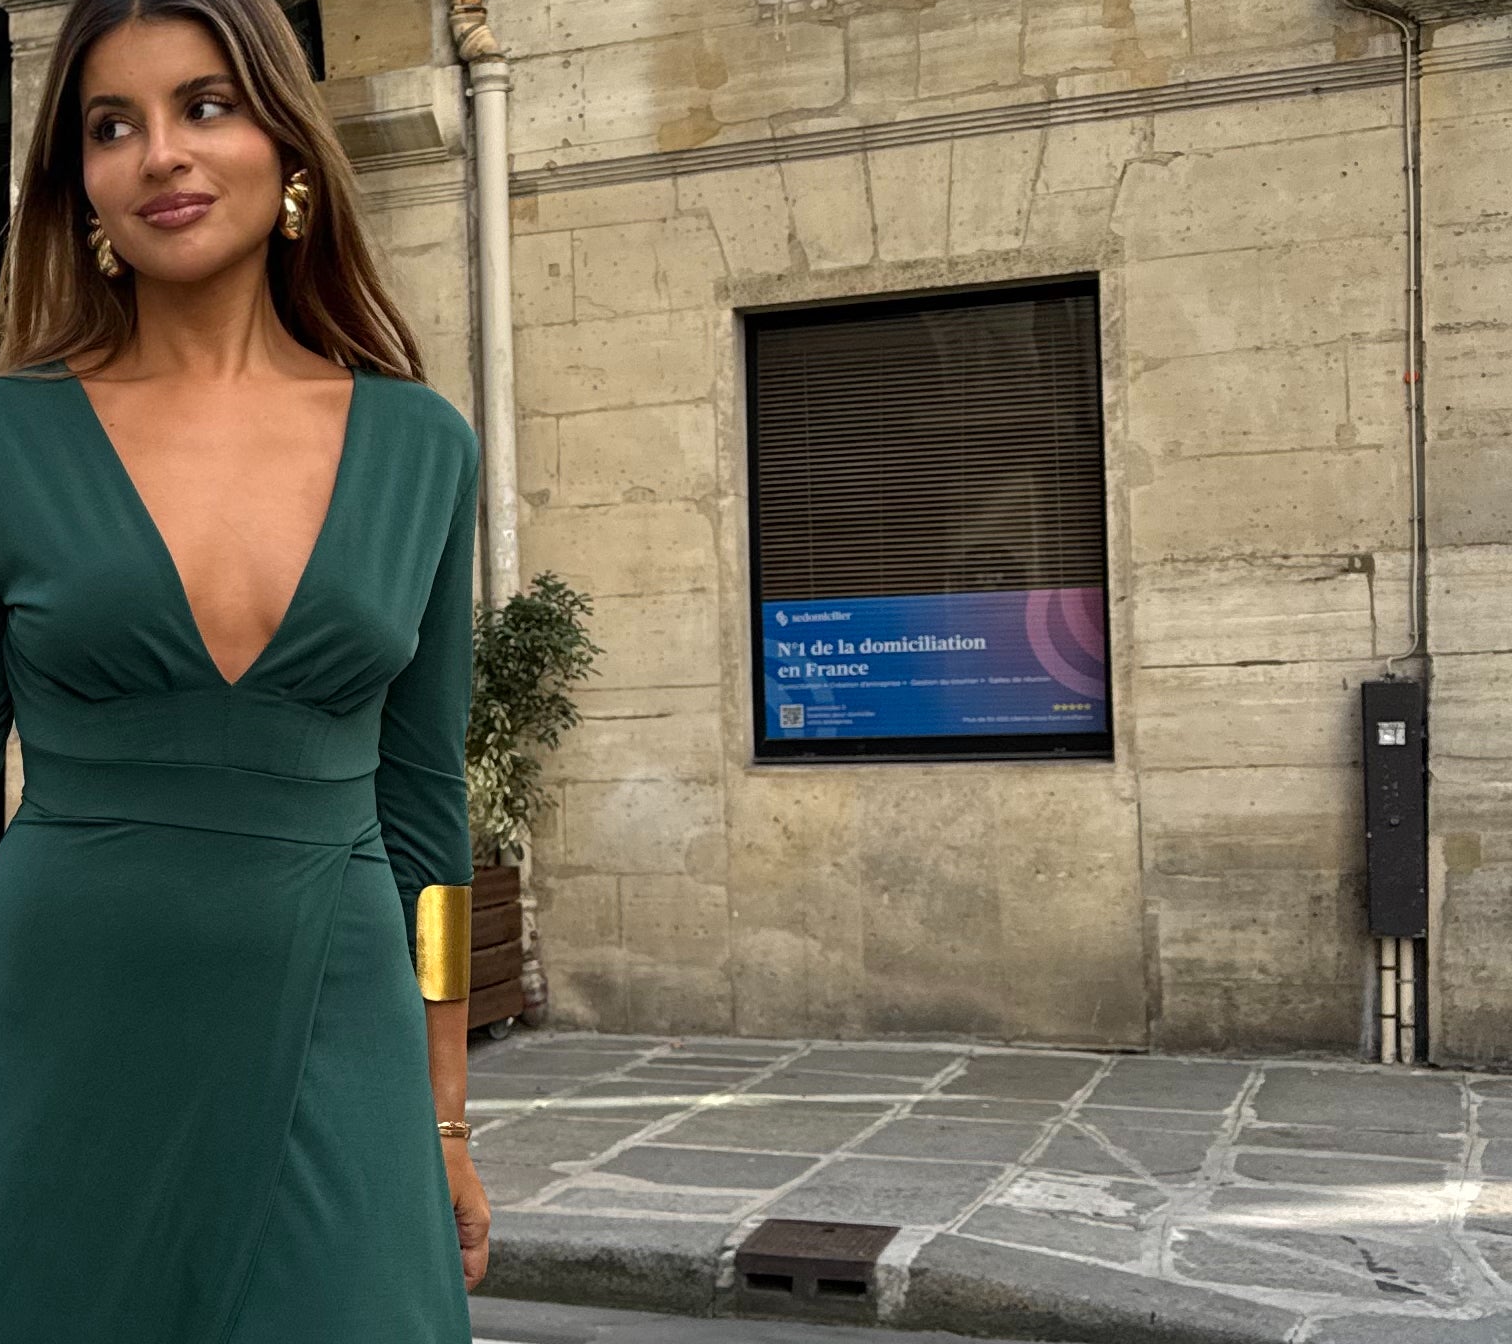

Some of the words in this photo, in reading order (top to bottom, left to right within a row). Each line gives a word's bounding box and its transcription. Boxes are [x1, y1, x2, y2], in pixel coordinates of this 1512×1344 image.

[777, 641, 806, 657] N°1
[810, 639, 834, 656] de
[838, 639, 856, 655] la
[859, 634, 987, 653] domiciliation
[777, 666, 801, 678] en
[805, 662, 870, 677] France
